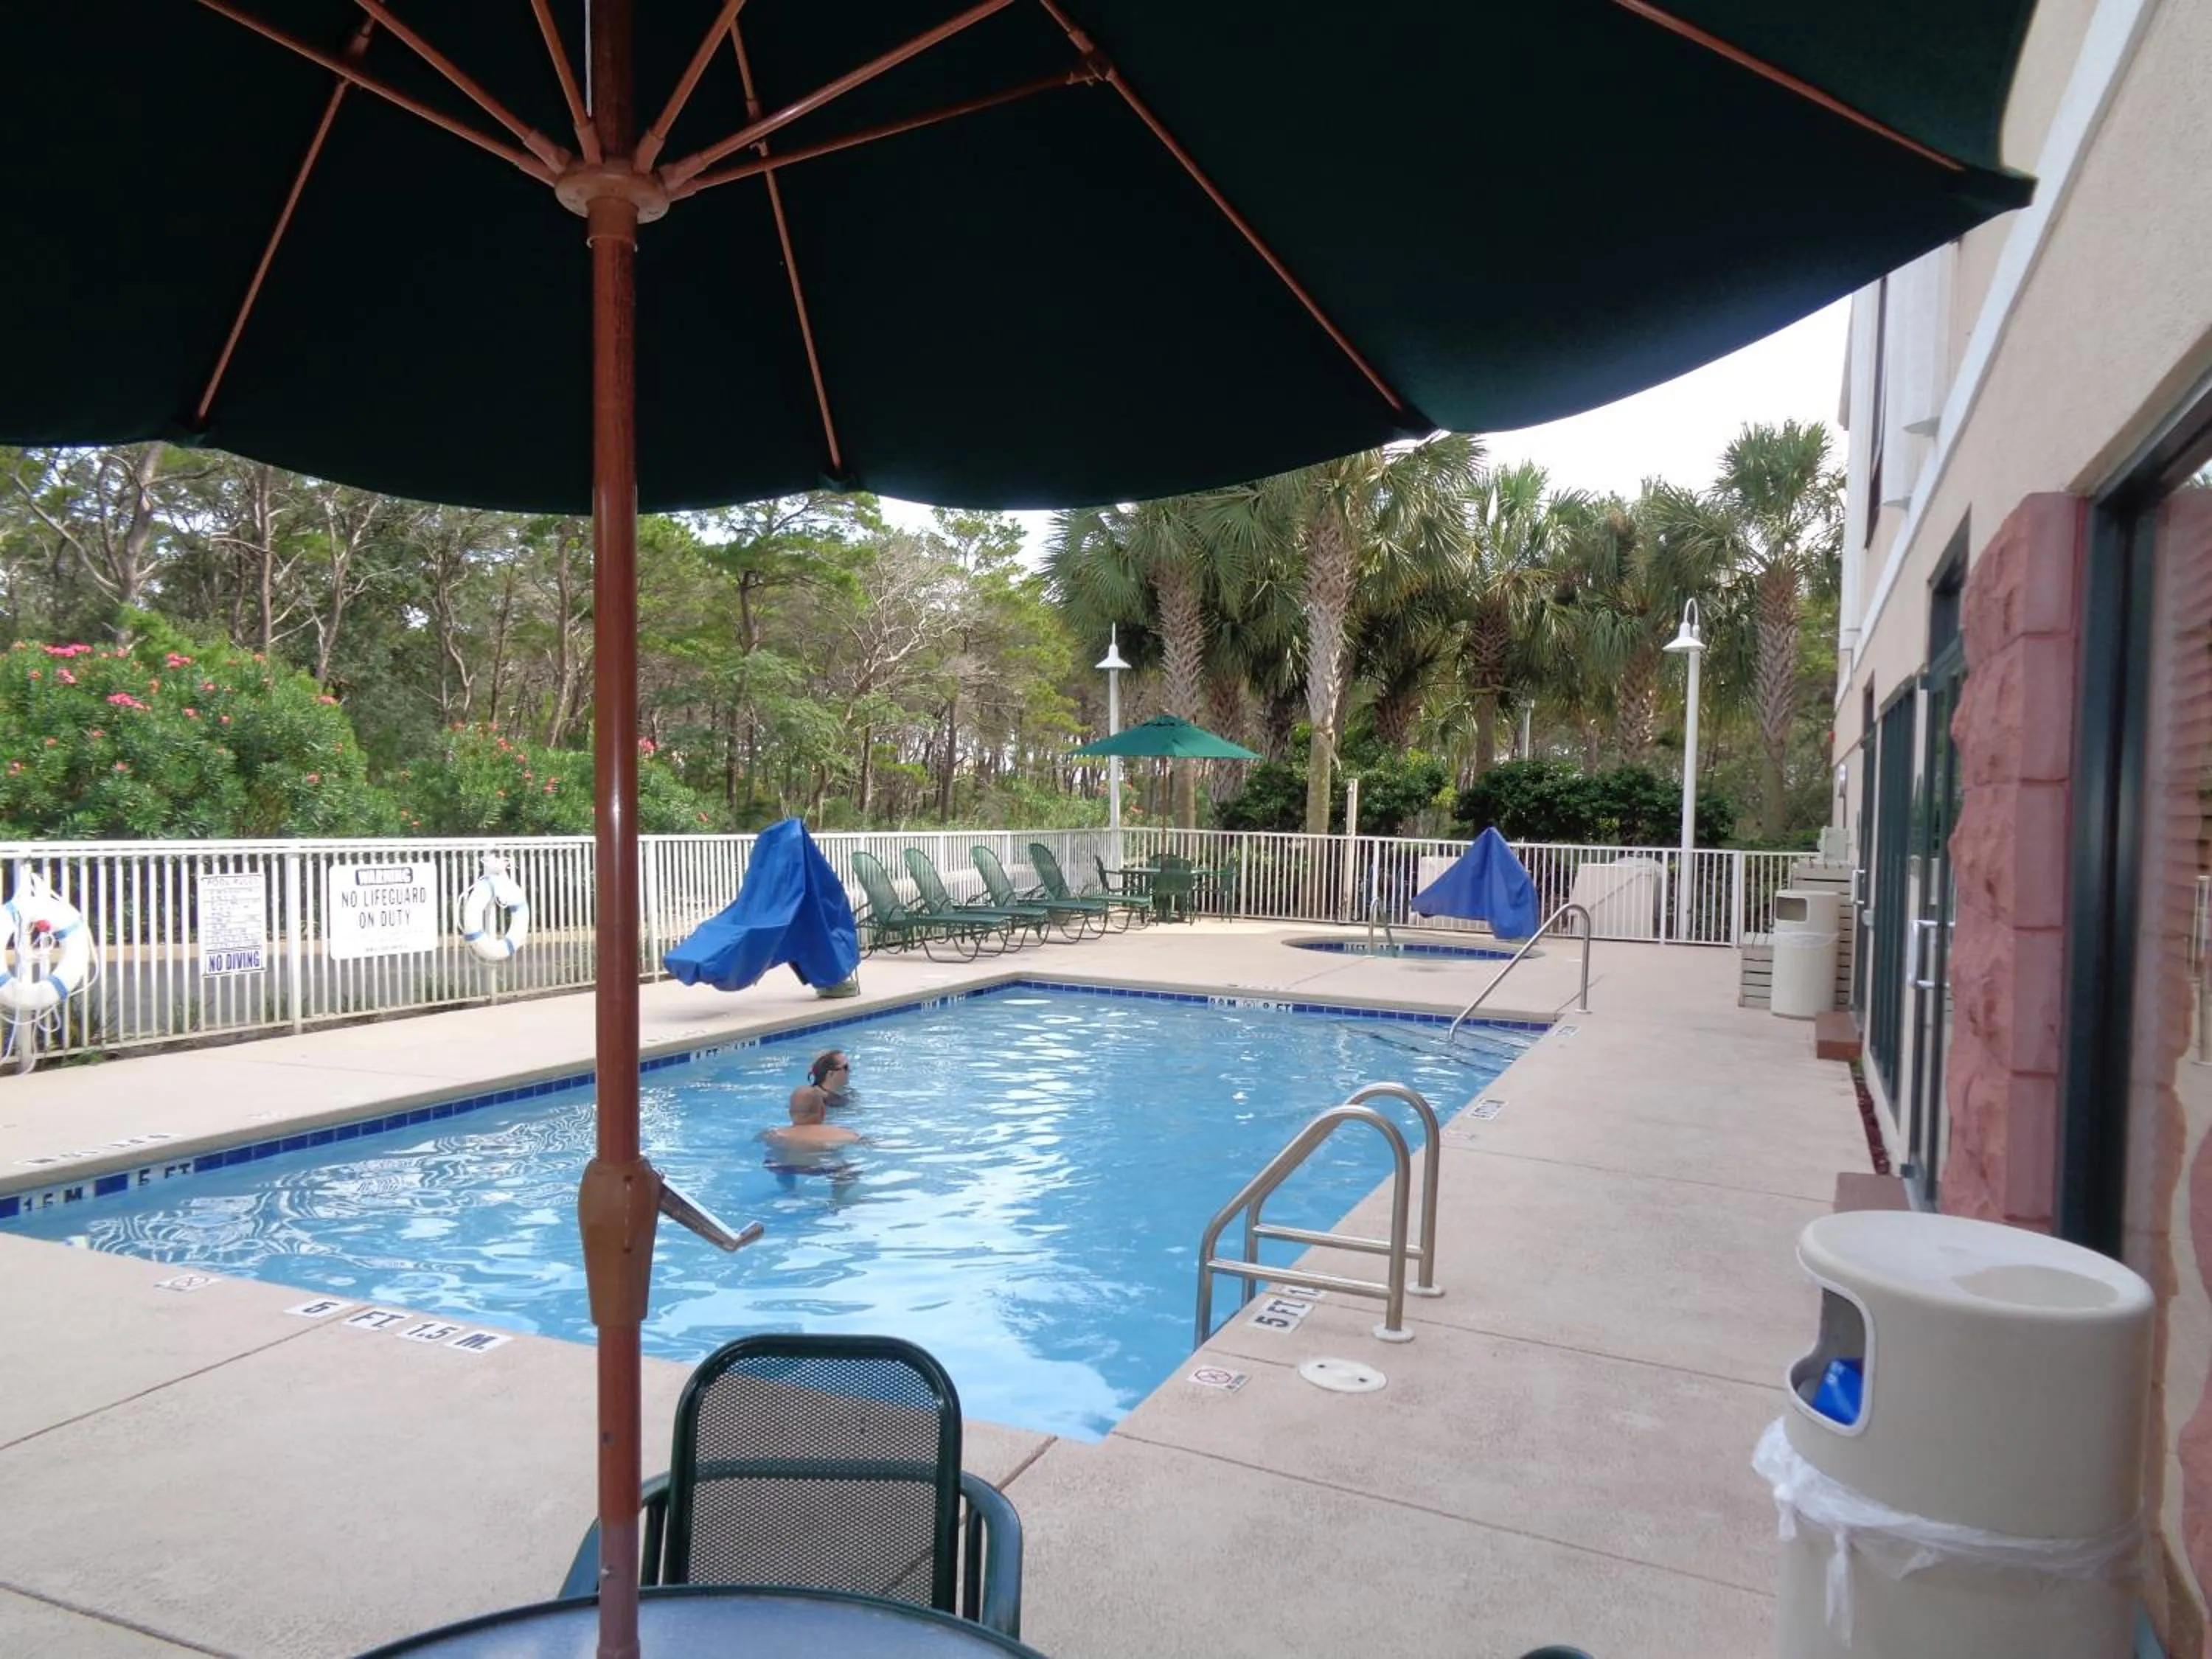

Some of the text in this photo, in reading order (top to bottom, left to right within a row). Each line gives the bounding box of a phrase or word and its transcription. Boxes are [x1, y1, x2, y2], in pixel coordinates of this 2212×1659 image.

[341, 887, 427, 908] NO LIFEGUARD
[359, 908, 411, 930] ON DUTY
[208, 950, 261, 973] NO DIVING
[407, 1322, 459, 1340] 1.5
[1254, 1315, 1289, 1328] 5
